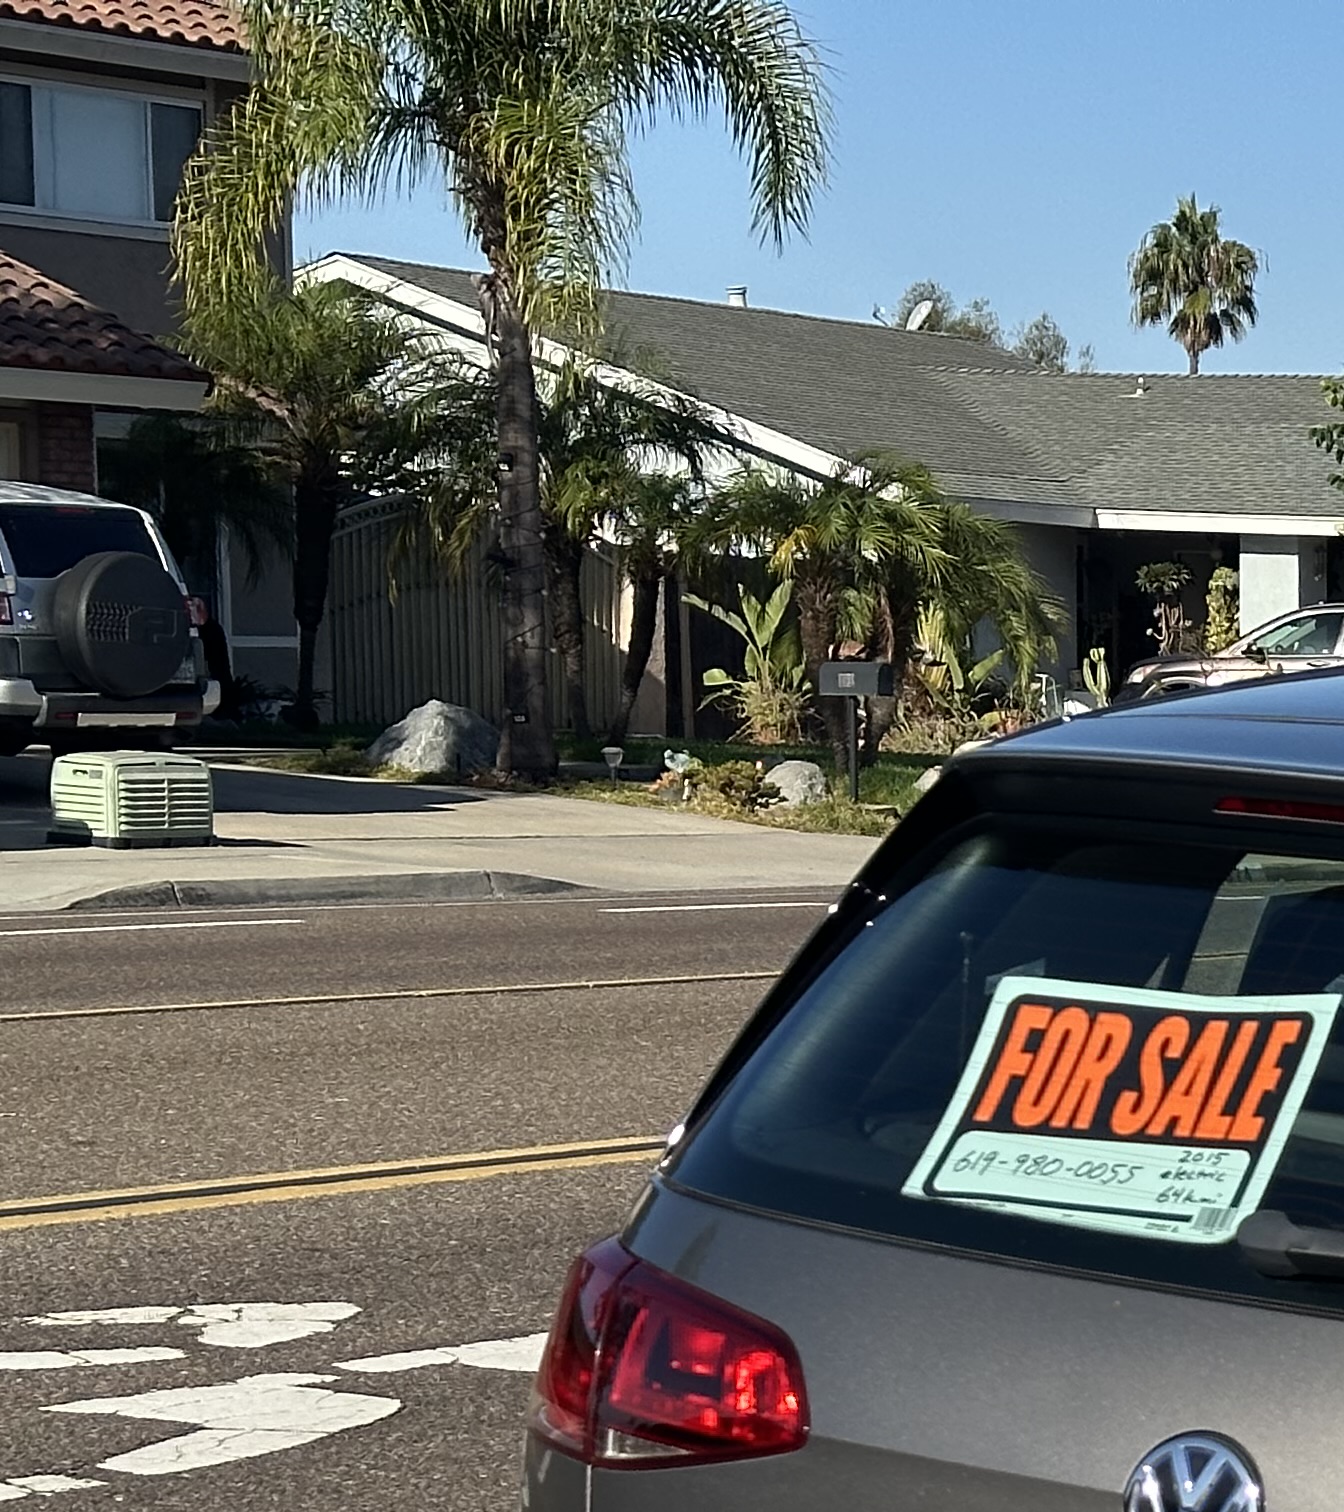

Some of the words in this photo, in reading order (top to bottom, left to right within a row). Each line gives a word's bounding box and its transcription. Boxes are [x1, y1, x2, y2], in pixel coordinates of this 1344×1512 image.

[973, 1003, 1133, 1130] FOR
[1111, 1015, 1302, 1141] SALE
[952, 1150, 1144, 1184] 619-980-0055
[1178, 1150, 1230, 1166] 2015
